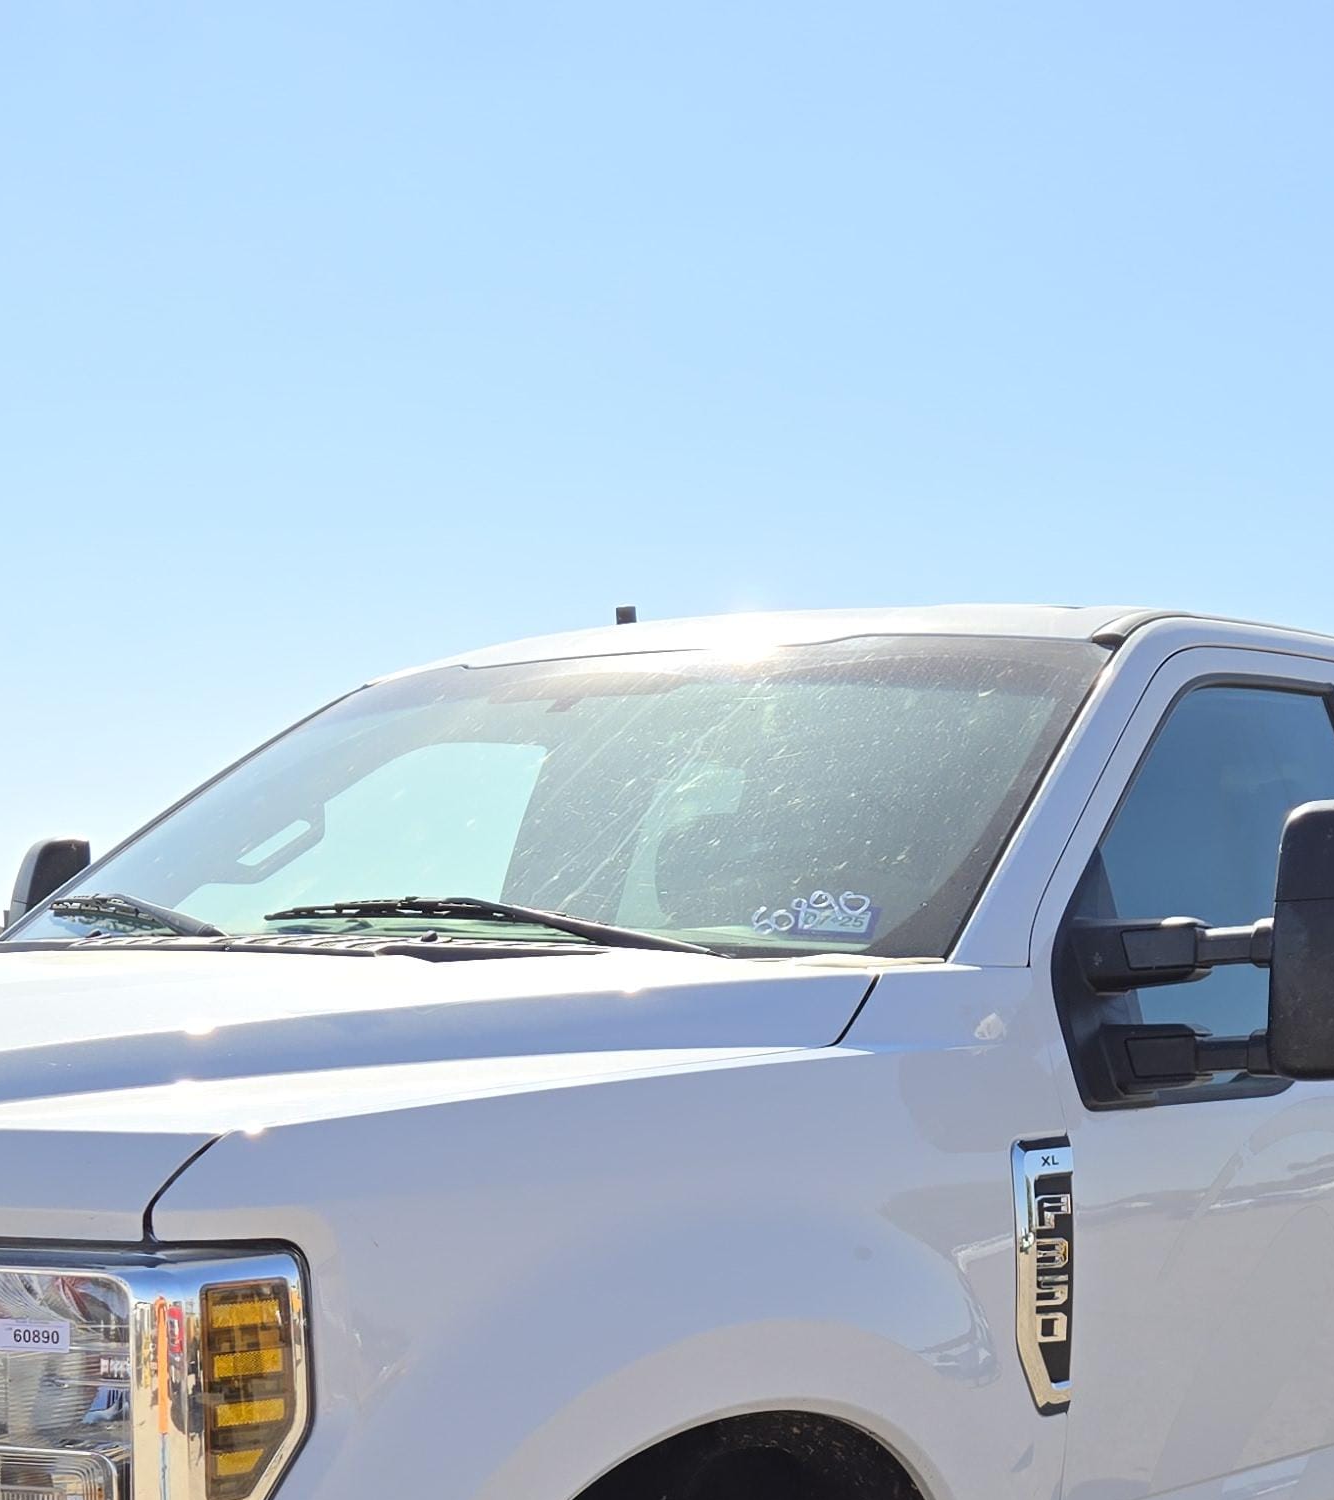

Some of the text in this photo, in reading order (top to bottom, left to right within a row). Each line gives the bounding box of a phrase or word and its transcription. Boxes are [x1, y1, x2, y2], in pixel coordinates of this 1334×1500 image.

[752, 890, 871, 936] 60890
[1040, 1154, 1060, 1168] XL
[13, 1329, 60, 1345] 60890
